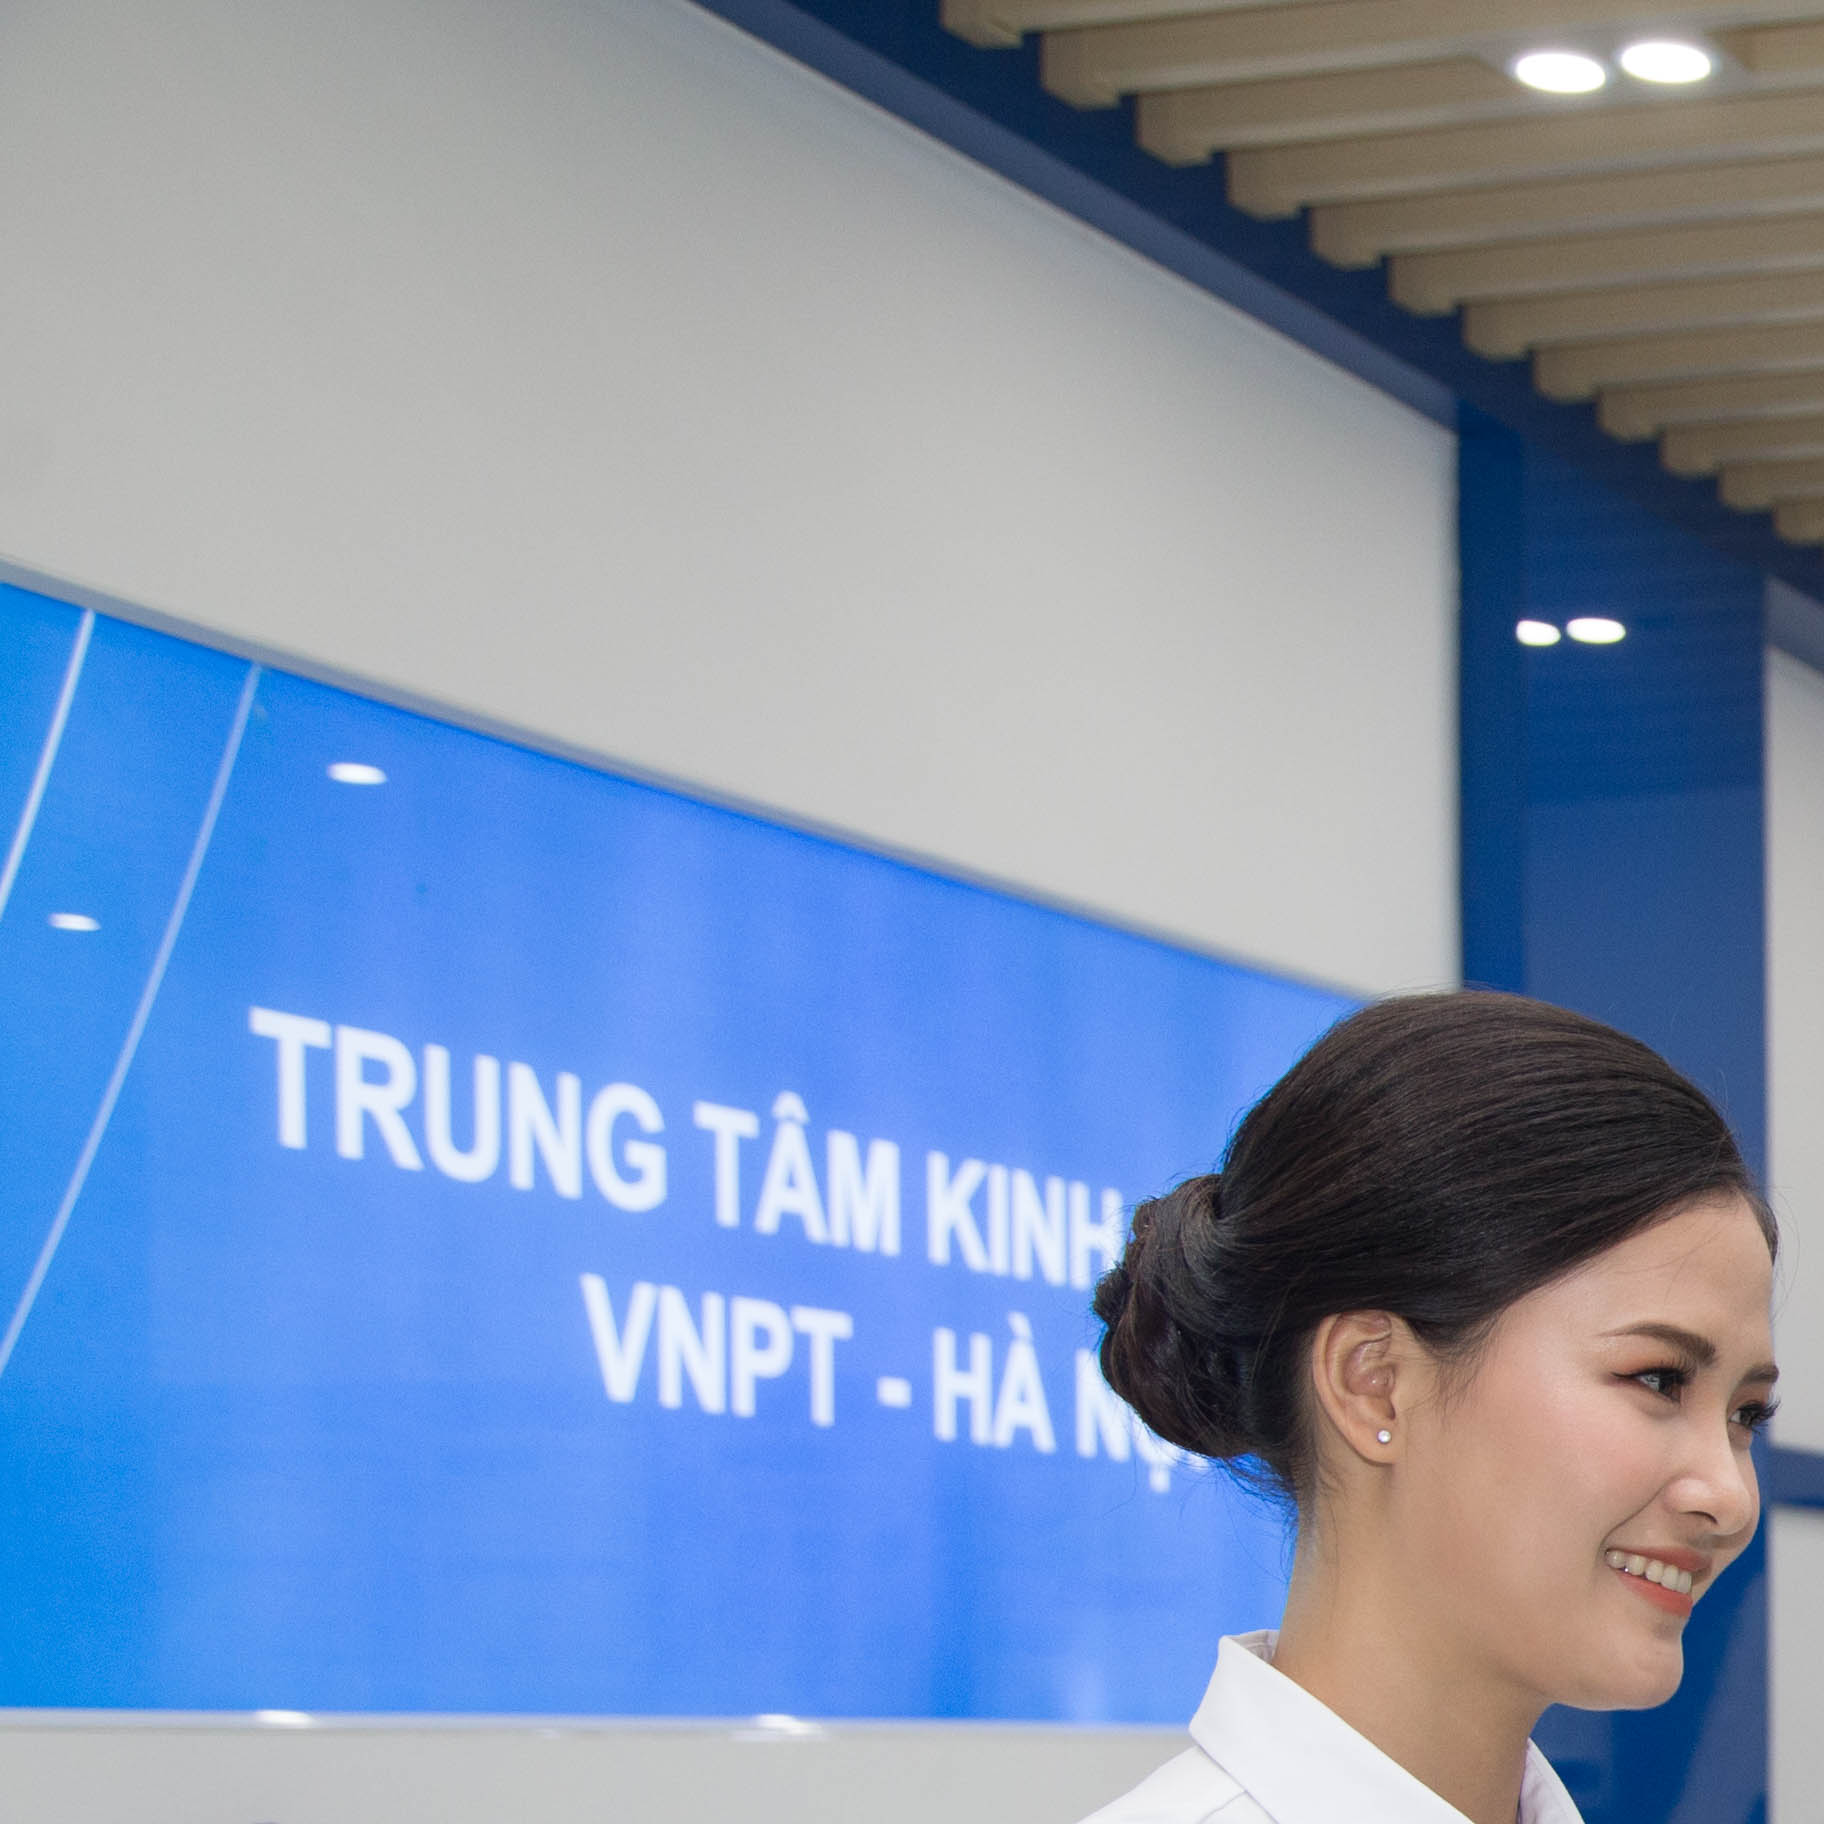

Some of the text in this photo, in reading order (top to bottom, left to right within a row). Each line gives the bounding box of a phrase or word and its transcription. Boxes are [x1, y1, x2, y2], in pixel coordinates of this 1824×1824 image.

[249, 1006, 1124, 1291] TRUNG TÂM KINH
[580, 1272, 853, 1428] VNPT
[877, 1376, 912, 1409] -
[933, 1311, 1056, 1454] HÀ
